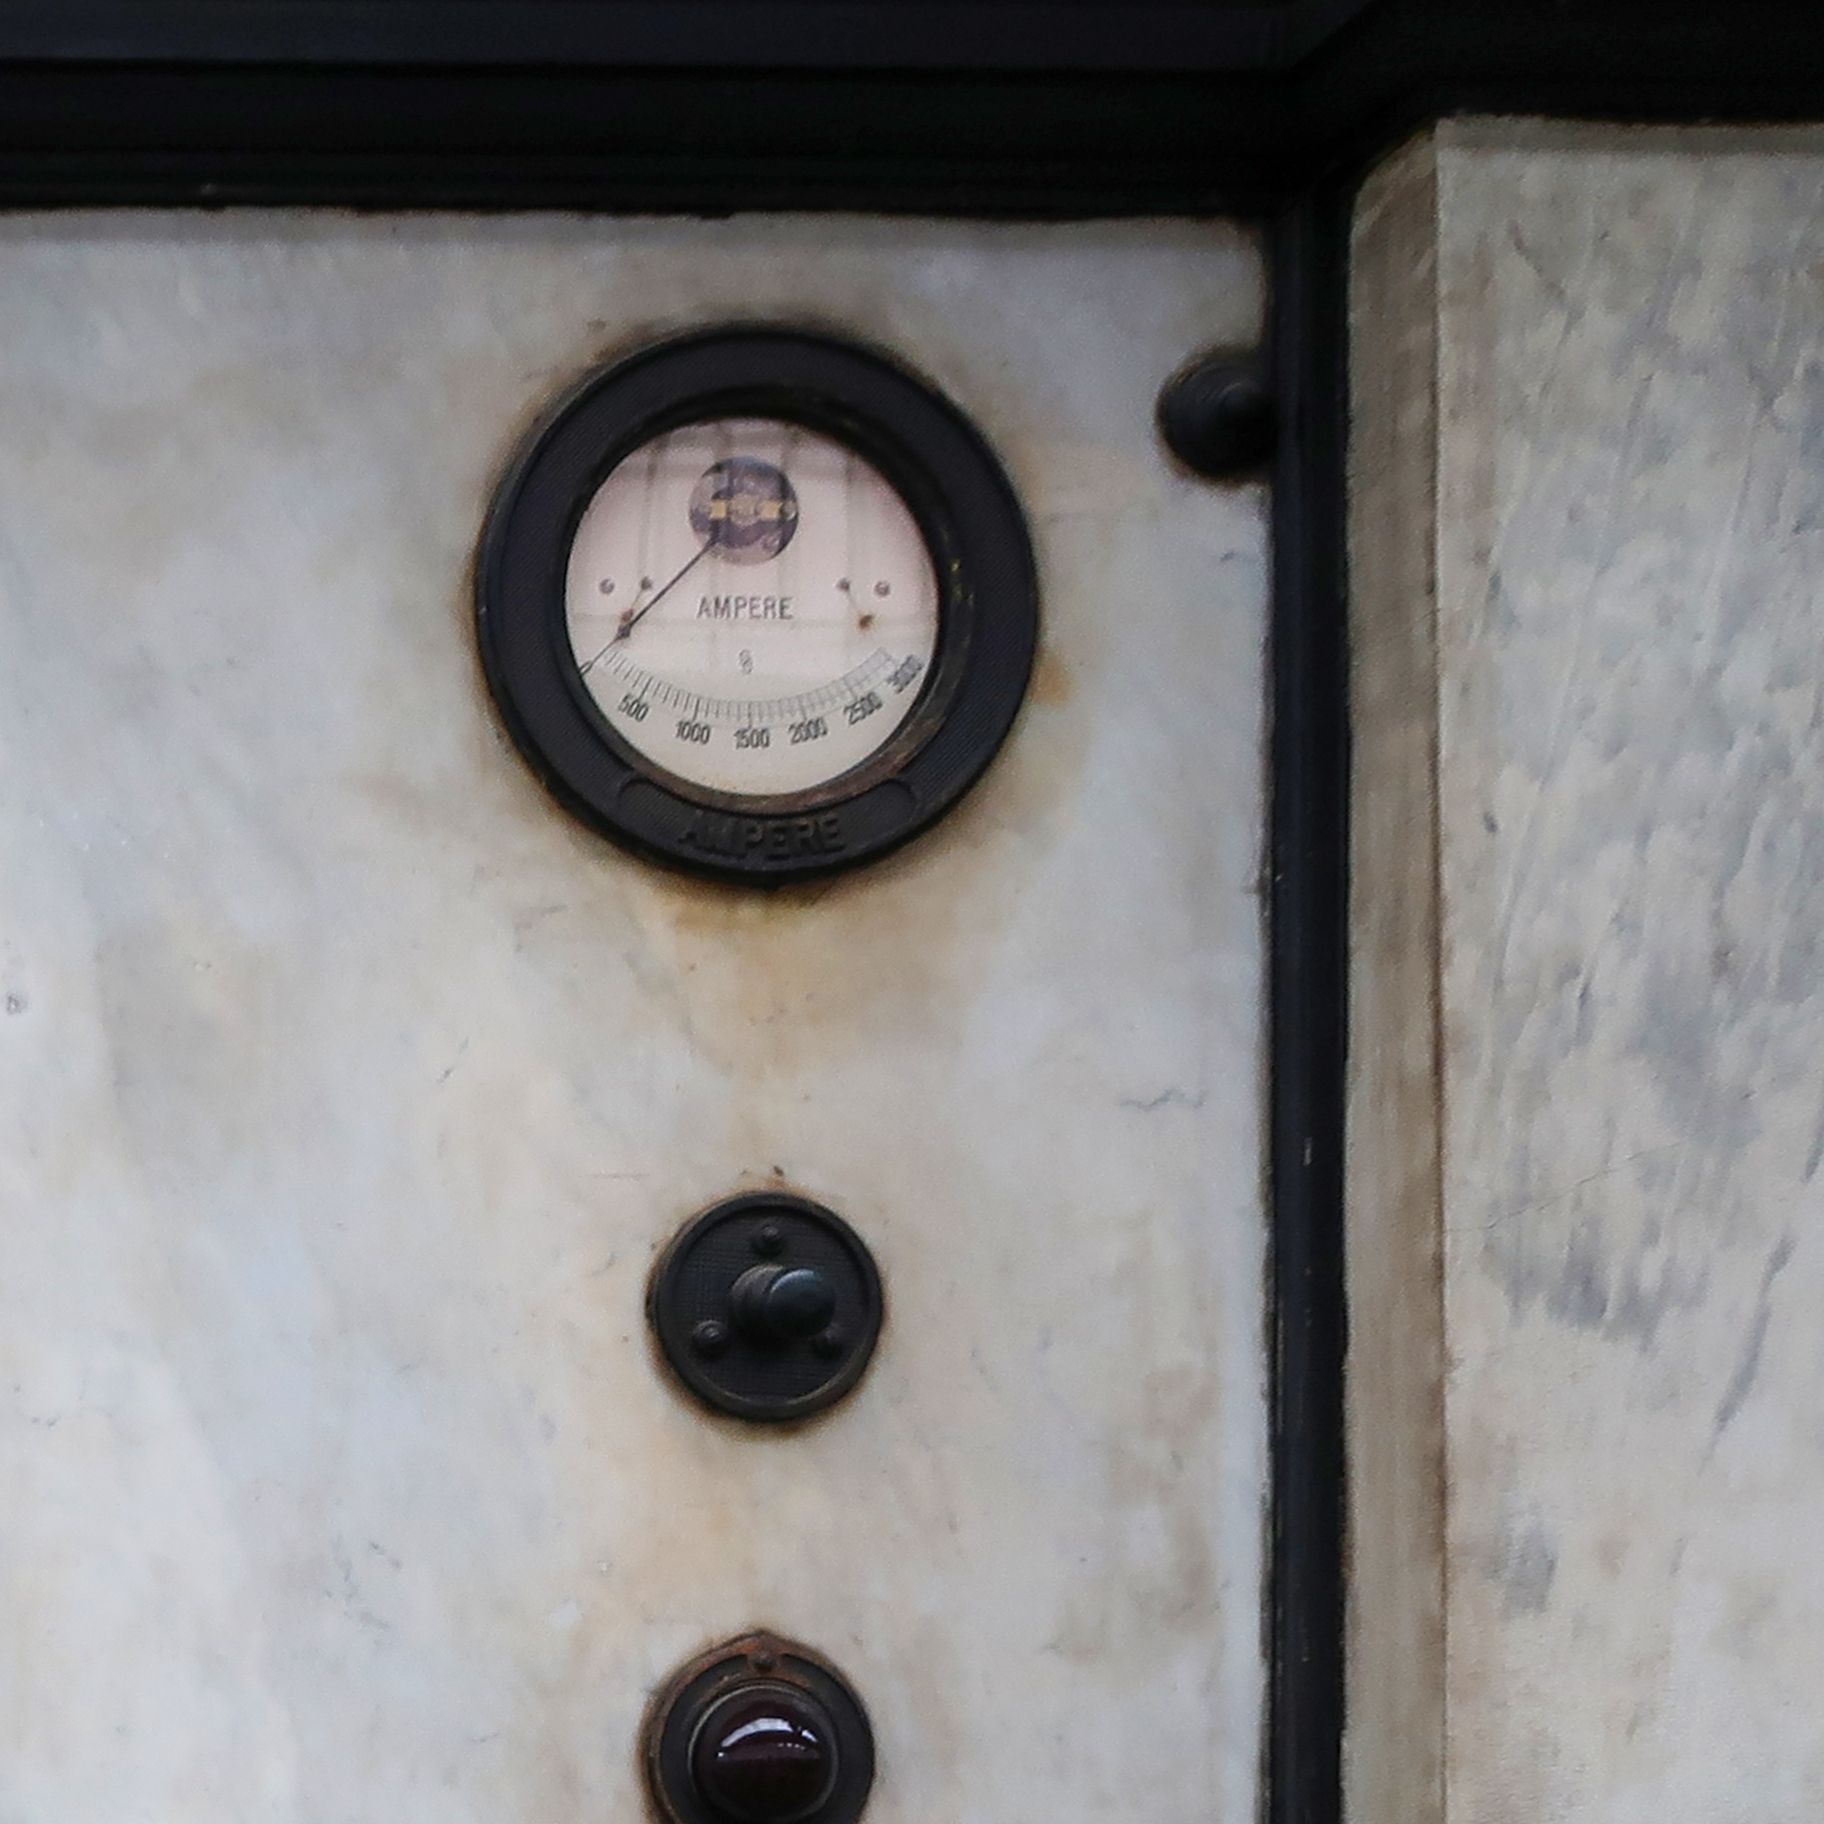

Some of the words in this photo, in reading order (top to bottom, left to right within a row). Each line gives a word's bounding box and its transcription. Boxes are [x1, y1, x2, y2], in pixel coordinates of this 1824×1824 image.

[696, 597, 793, 620] AMPERE
[619, 693, 649, 723] 500
[675, 721, 710, 745] 1000
[734, 728, 770, 748] 1500
[789, 717, 827, 745] 2000
[844, 691, 880, 725] 2500
[886, 654, 924, 691] 3000
[678, 816, 847, 862] AMPERE
